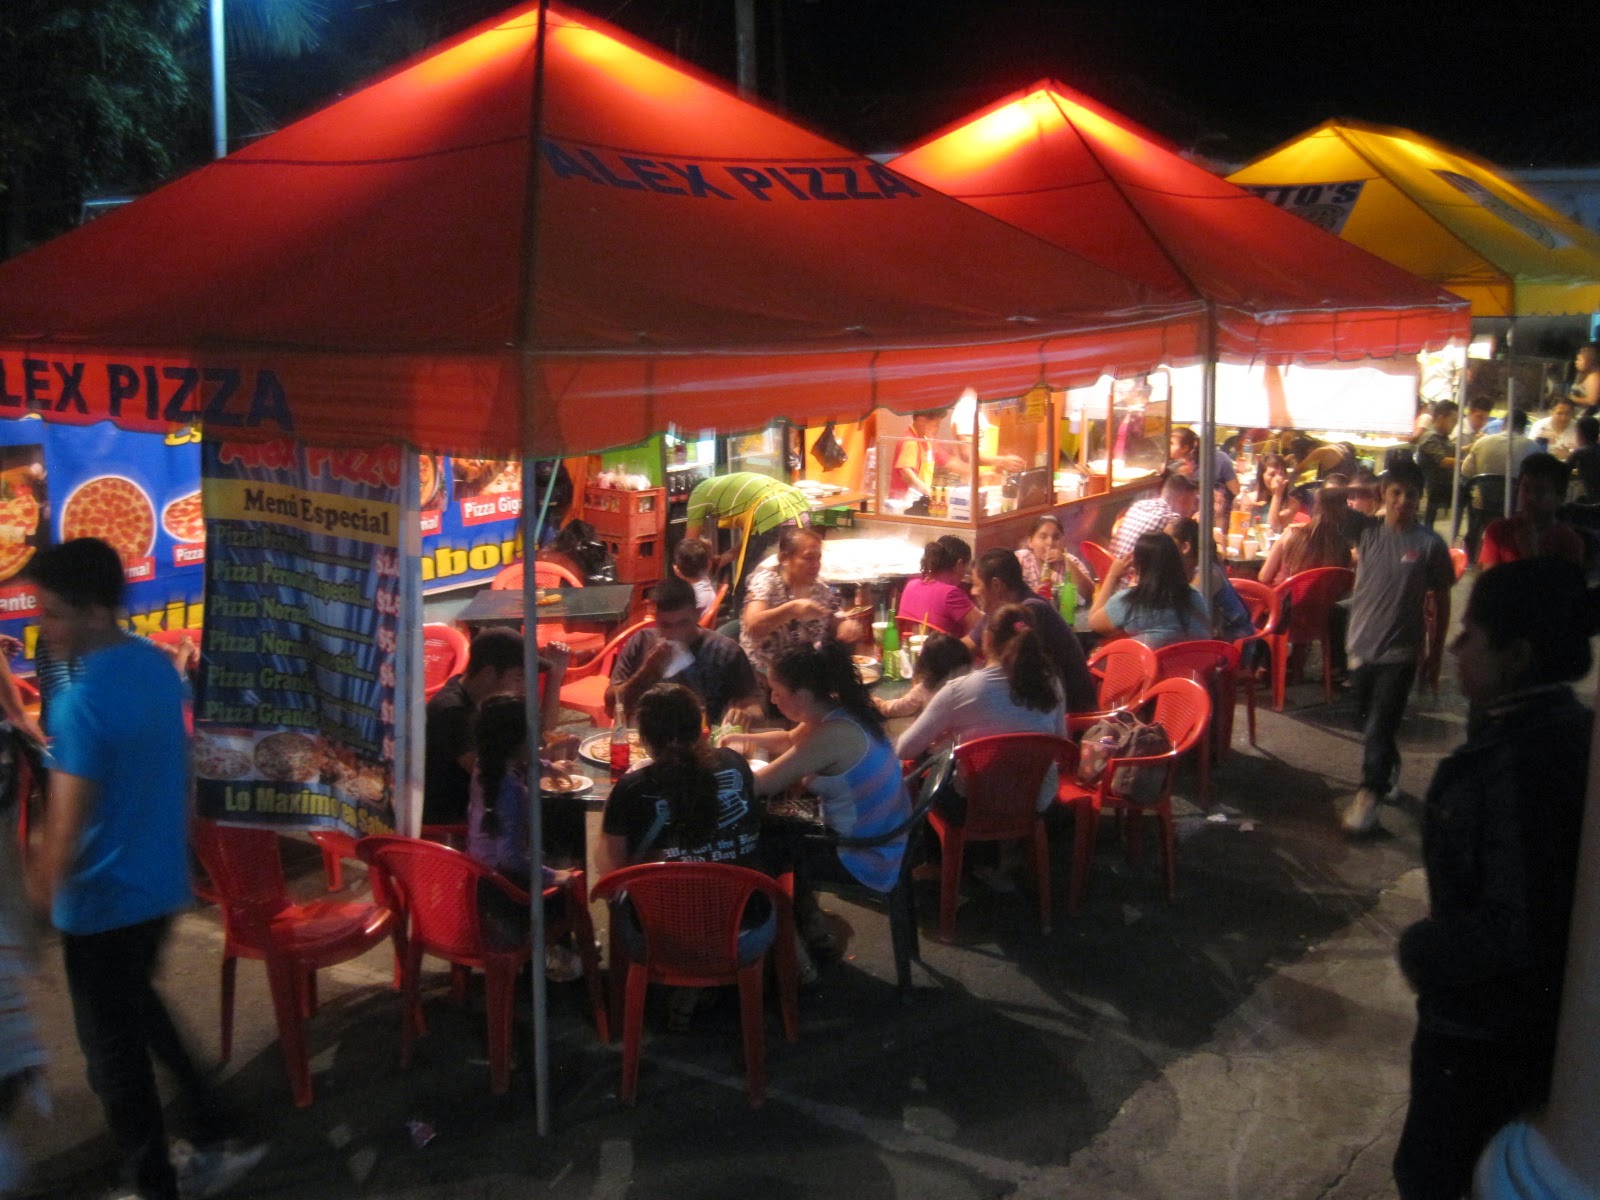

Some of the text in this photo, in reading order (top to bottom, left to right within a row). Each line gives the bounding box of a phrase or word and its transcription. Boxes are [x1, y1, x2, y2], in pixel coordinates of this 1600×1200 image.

[539, 138, 922, 202] ALEX PIZZA
[107, 362, 294, 431] PIZZA
[301, 498, 391, 537] Especial
[463, 498, 496, 519] Pizza
[212, 560, 257, 582] Pizza
[211, 596, 257, 617] Pizza
[209, 630, 256, 652] Pizza
[207, 665, 255, 688] Pizza
[205, 700, 254, 723] Pizza
[224, 785, 251, 811] Lo
